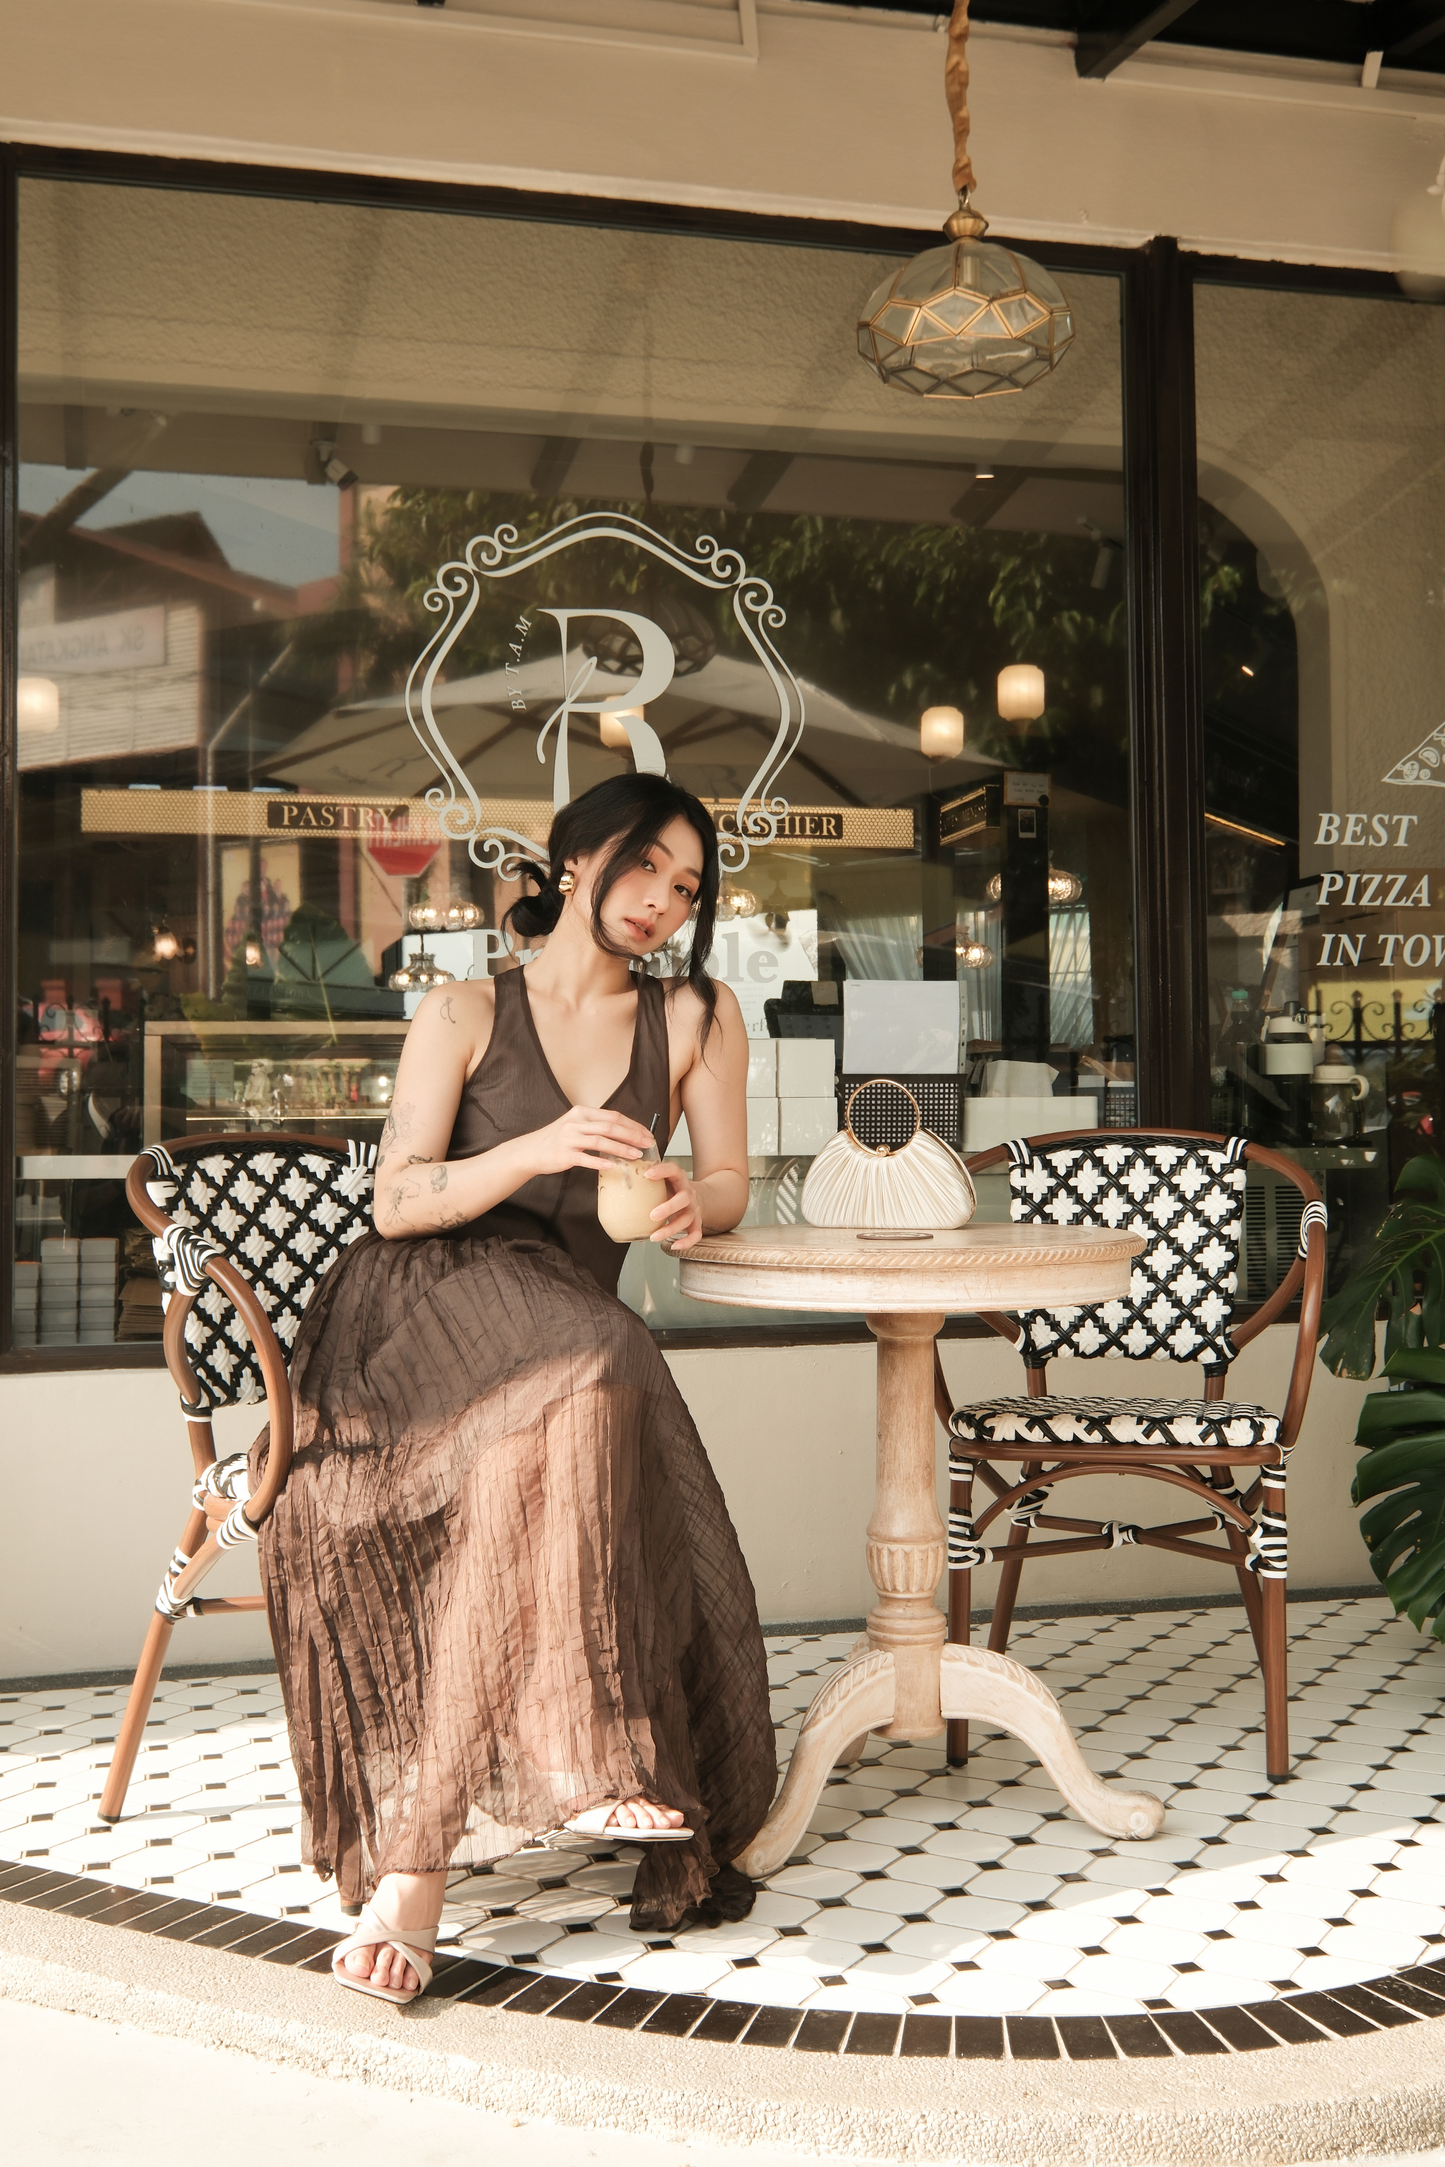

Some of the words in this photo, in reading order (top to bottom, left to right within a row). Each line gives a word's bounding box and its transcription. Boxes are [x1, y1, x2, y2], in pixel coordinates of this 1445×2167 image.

[505, 615, 532, 677] T.A.M
[508, 686, 527, 711] BY
[536, 608, 675, 815] R
[281, 805, 396, 828] PASTRY
[718, 814, 838, 836] CASHIER
[1314, 813, 1418, 847] BEST
[1315, 873, 1431, 907] PIZZA
[1316, 933, 1366, 967] IN
